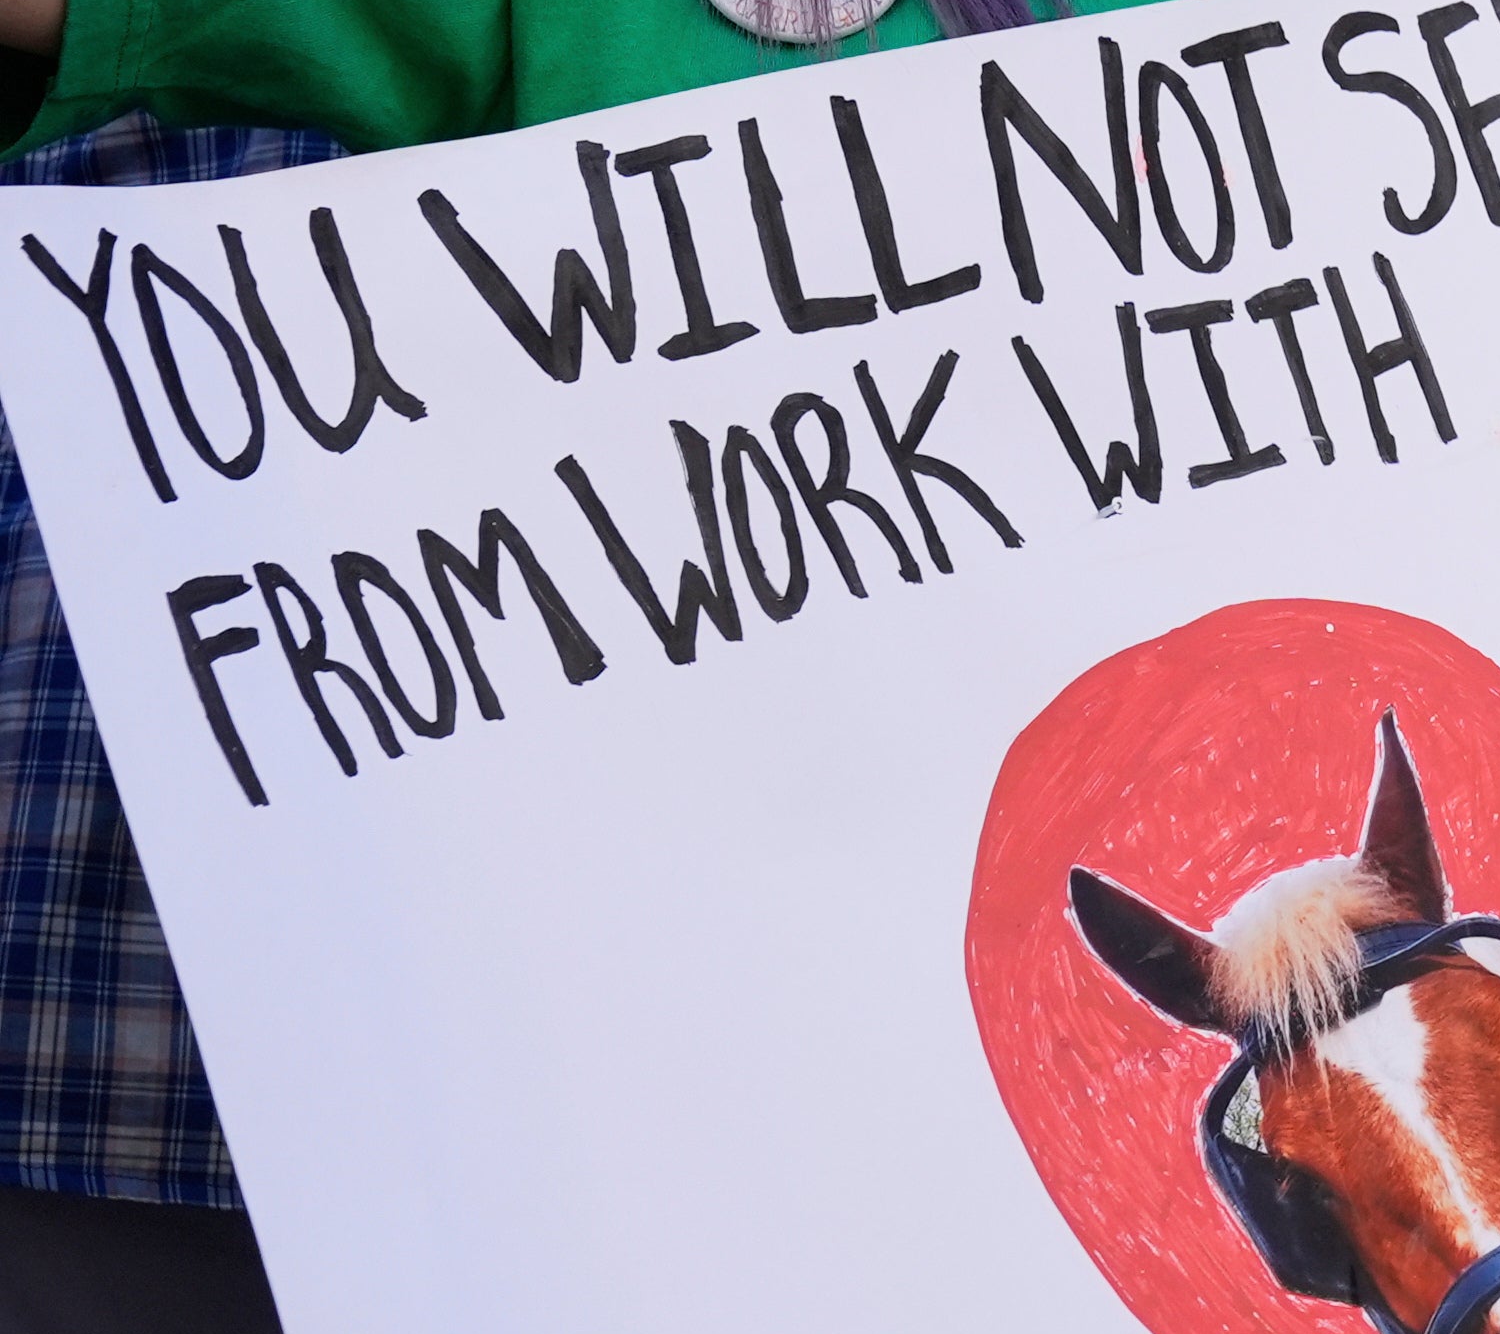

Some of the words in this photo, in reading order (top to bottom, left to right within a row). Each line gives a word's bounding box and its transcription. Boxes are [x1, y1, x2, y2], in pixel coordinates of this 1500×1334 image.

[21, 207, 428, 503] YOU
[417, 96, 981, 383] WILL
[980, 22, 1293, 304] NOT
[166, 502, 606, 807] FROM
[562, 351, 1025, 667] WORK
[1011, 251, 1460, 512] WITH
